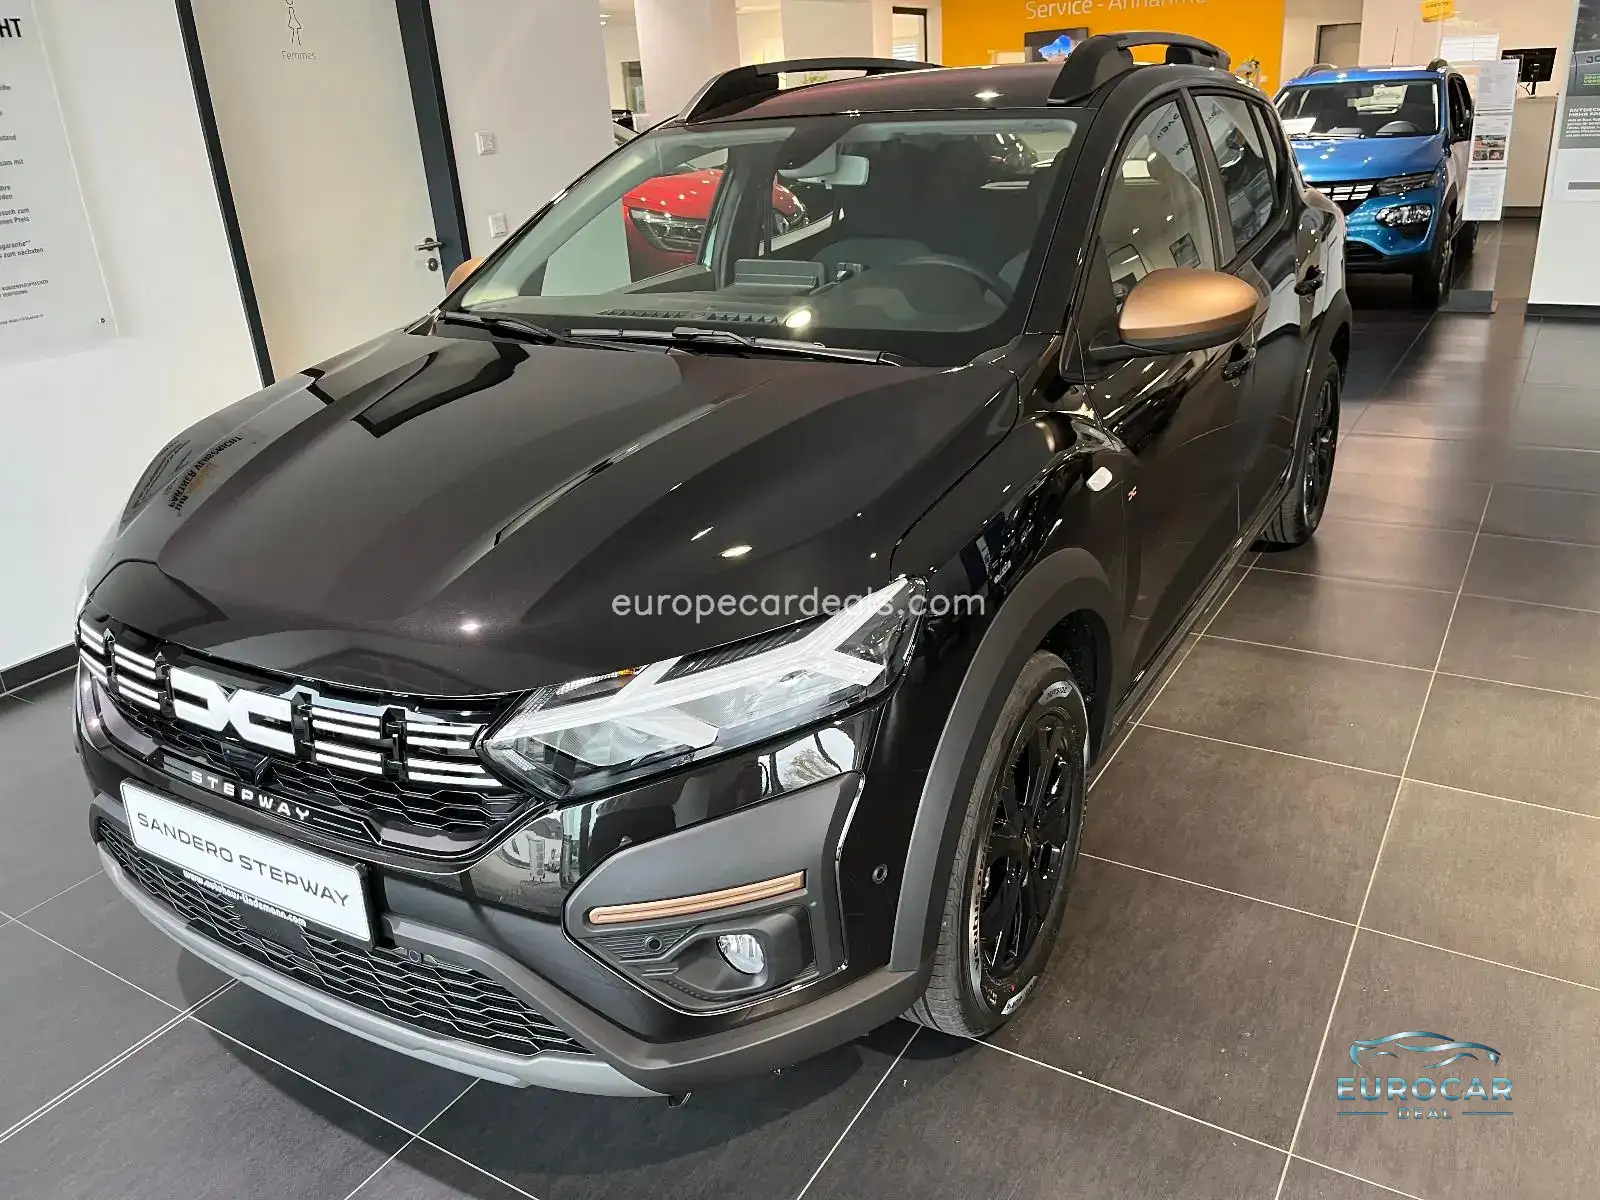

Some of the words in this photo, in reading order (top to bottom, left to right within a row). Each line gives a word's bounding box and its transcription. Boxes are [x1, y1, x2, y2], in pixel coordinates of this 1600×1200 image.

[1025, 1, 1092, 20] Service
[1108, 0, 1206, 11] Anna
[281, 50, 317, 60] Femmes
[190, 770, 310, 822] STEPWAY
[136, 811, 234, 863] SANDERO
[239, 854, 350, 908] STEPWAY
